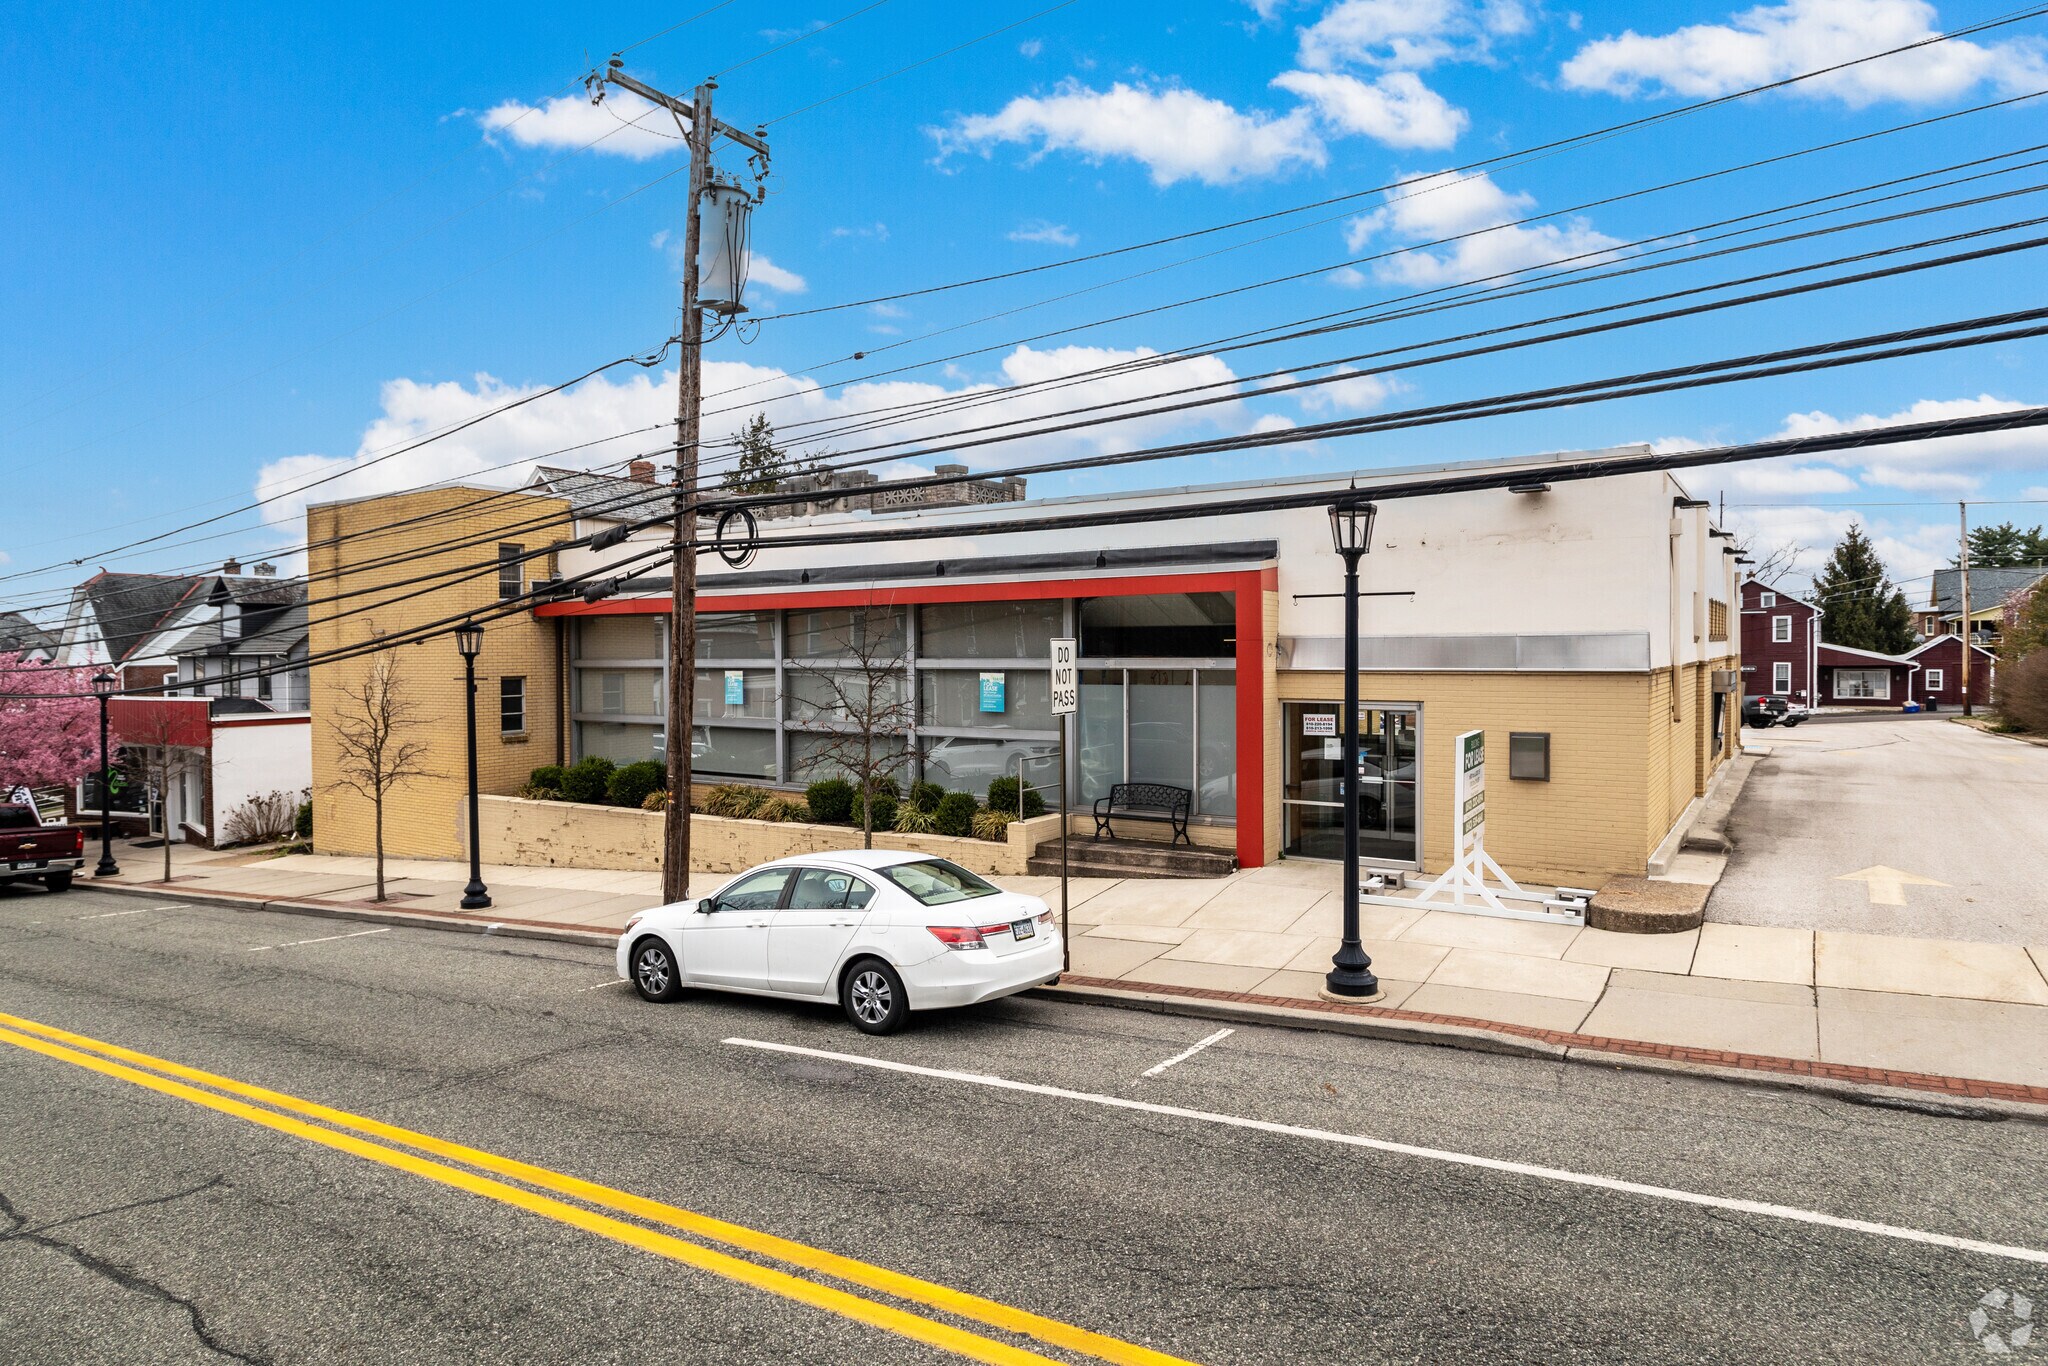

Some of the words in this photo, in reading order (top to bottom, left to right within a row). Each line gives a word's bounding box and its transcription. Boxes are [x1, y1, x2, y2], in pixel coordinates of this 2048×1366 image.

[1058, 646, 1069, 663] DO
[1055, 668, 1072, 685] NOT
[1053, 689, 1075, 707] PASS
[1465, 752, 1474, 771] FOR
[1474, 746, 1485, 766] LEASE
